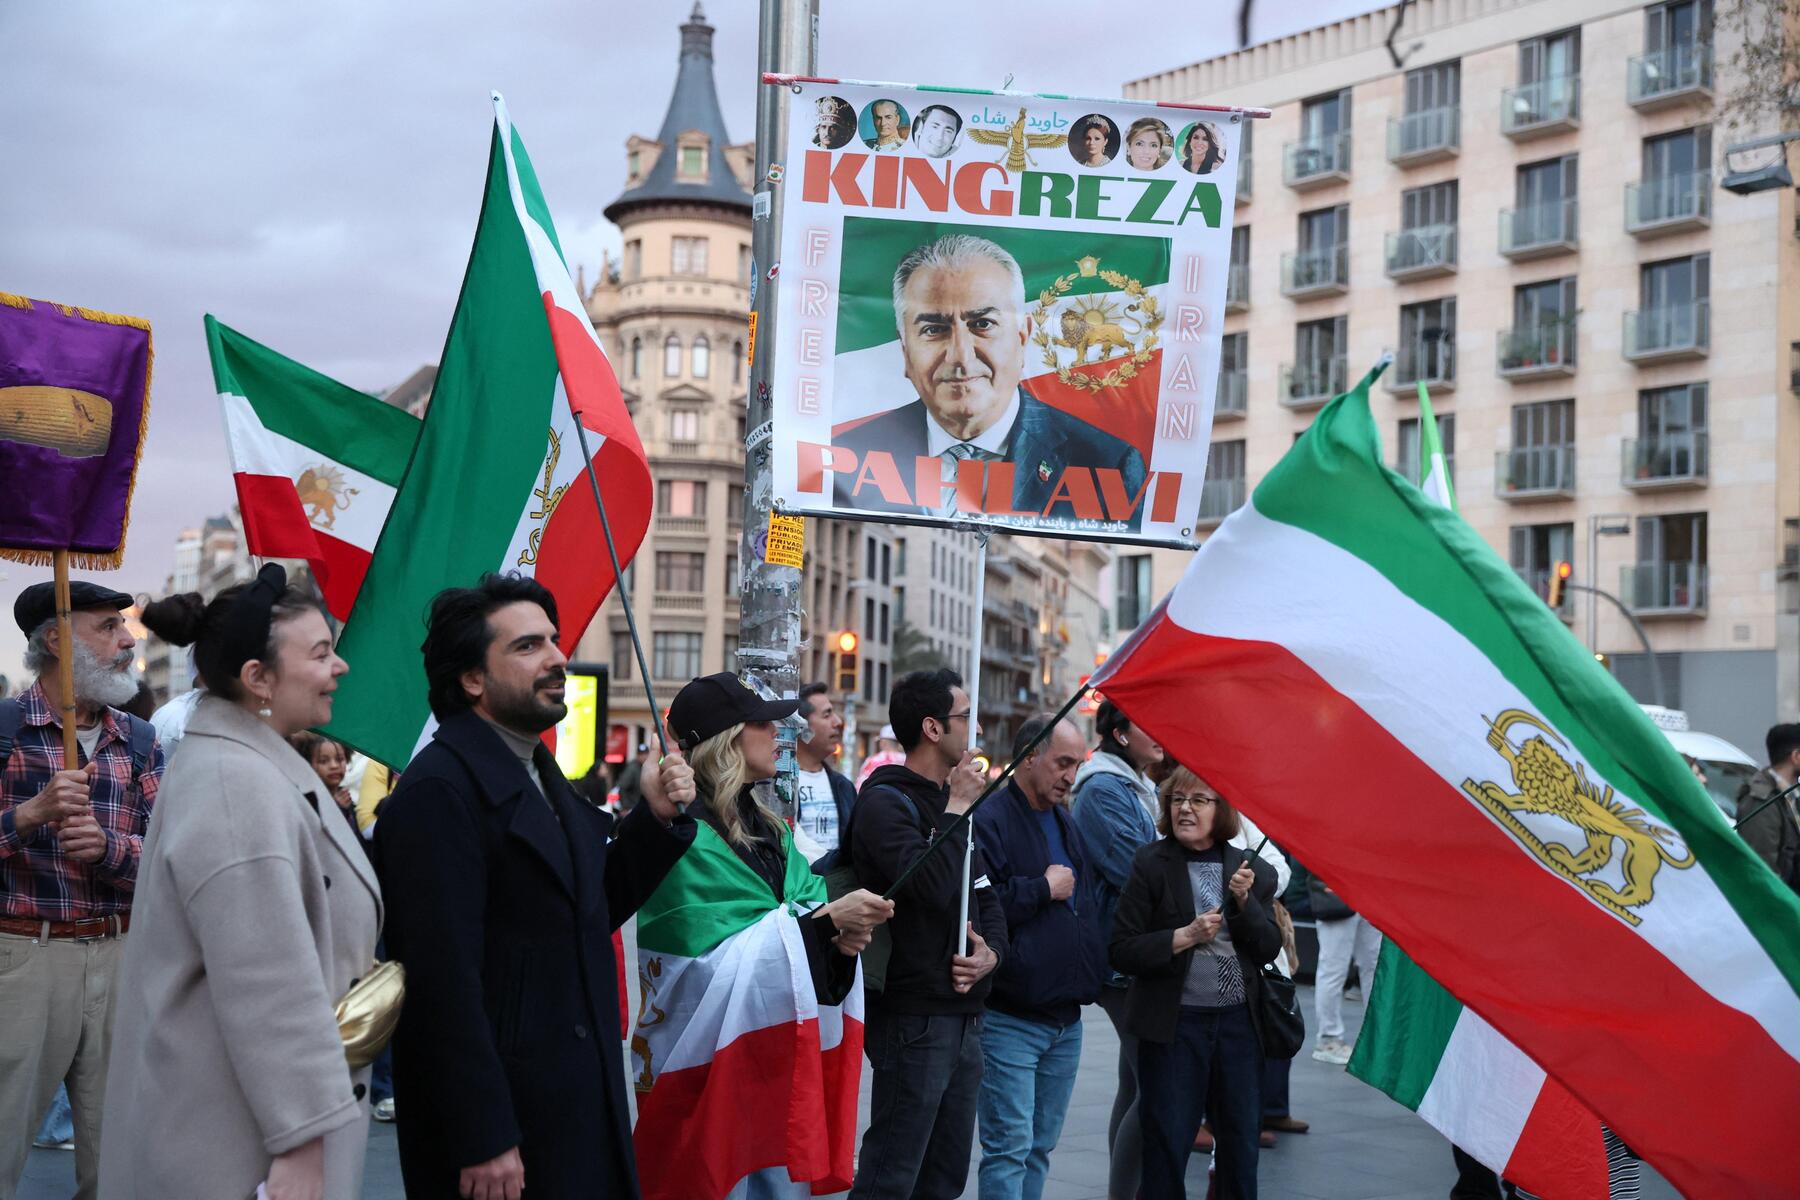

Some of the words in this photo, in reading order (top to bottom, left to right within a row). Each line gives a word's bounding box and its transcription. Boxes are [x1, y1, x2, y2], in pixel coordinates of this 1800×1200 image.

[971, 106, 1008, 126] شاه
[1028, 111, 1070, 132] جاوید
[803, 150, 1013, 216] KING
[1019, 170, 1224, 229] REZA
[798, 229, 831, 415] FREE
[1162, 256, 1204, 440] IRAN
[797, 441, 1182, 522] PAHLAVI
